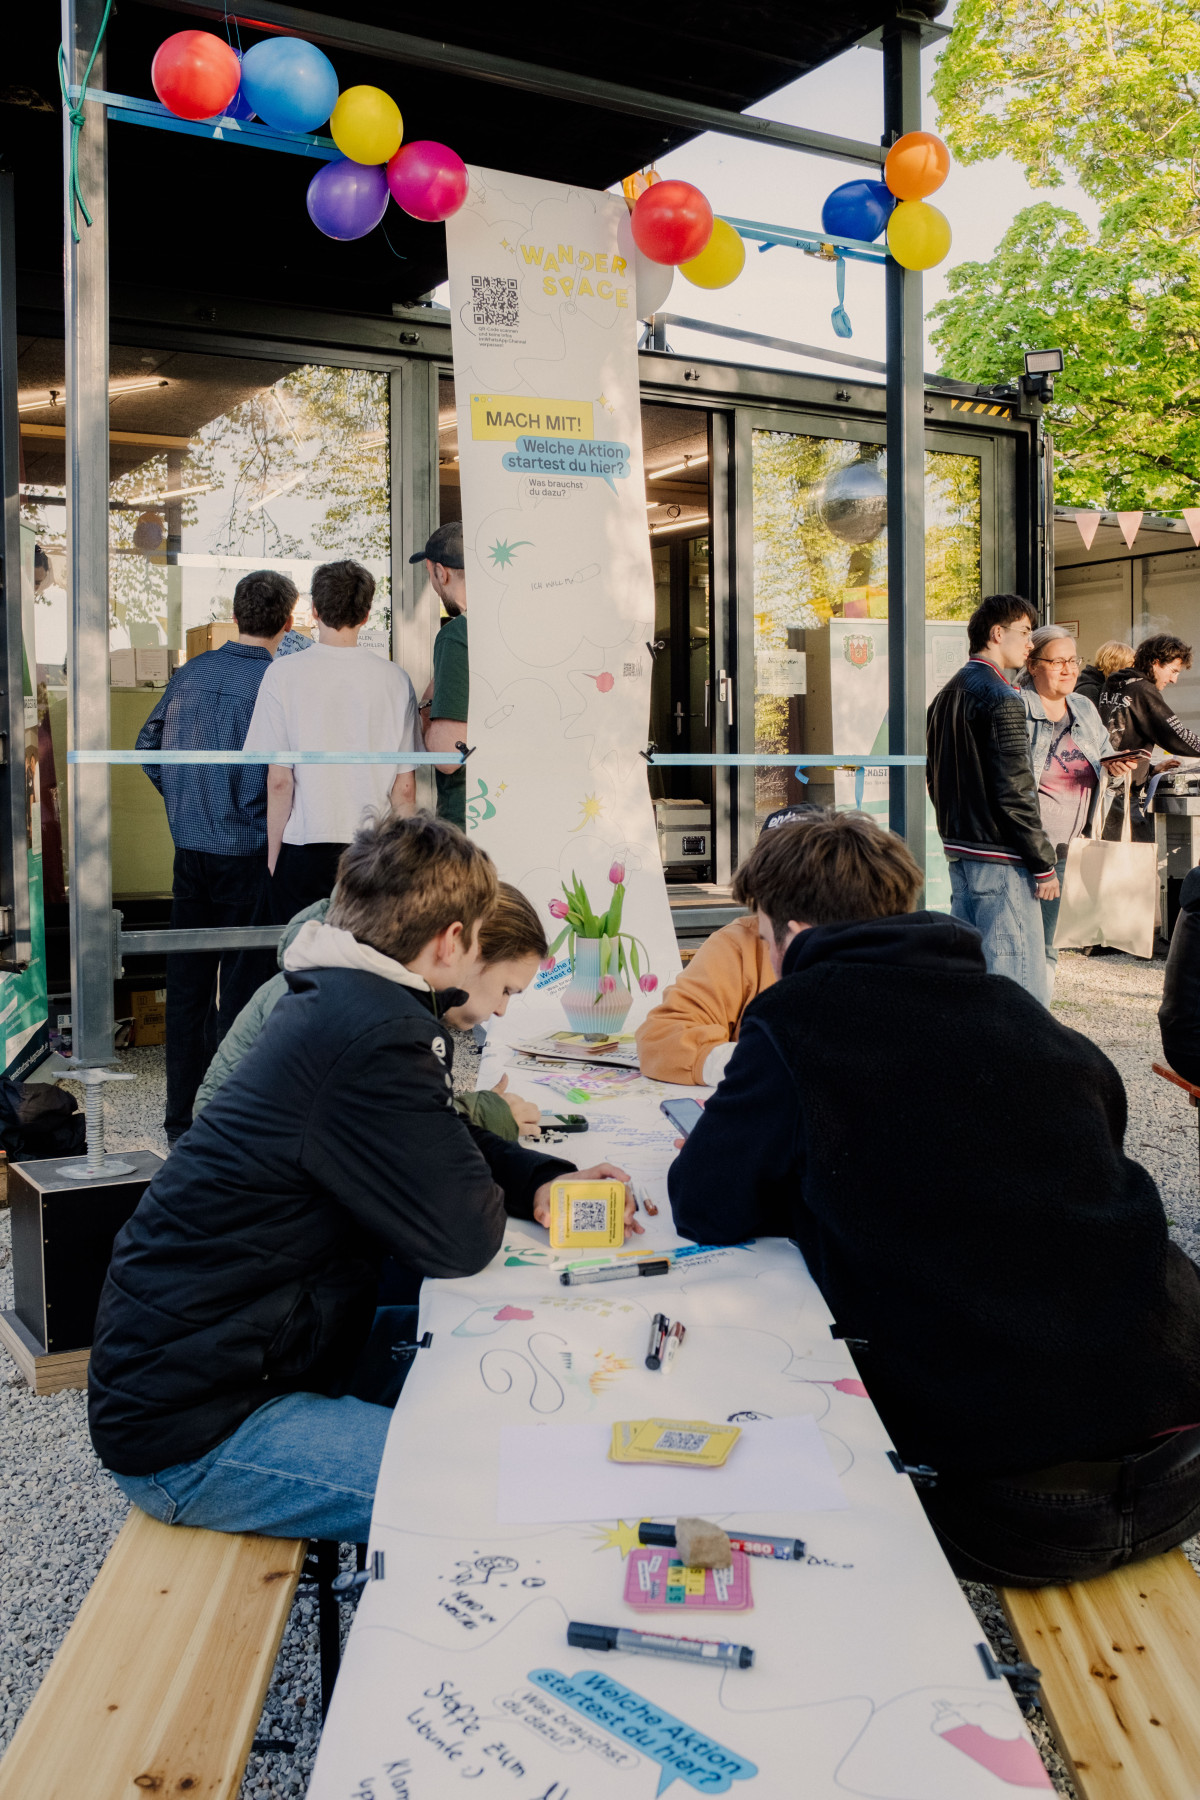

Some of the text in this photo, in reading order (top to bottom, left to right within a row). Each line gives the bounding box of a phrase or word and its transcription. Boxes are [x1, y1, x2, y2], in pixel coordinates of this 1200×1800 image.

[520, 244, 627, 277] WANDER
[543, 276, 628, 308] SPACE
[486, 411, 581, 432] MACH MIT!
[523, 439, 624, 458] Welche Aktion
[508, 456, 624, 474] startest du hier?
[529, 479, 583, 489] Was brauchst
[529, 488, 566, 497] du dazu?
[502, 1700, 576, 1747] du dazu?
[522, 1692, 628, 1764] Was brauchst
[538, 1672, 722, 1785] startest du hier?
[584, 1674, 742, 1776] Welche Aktion
